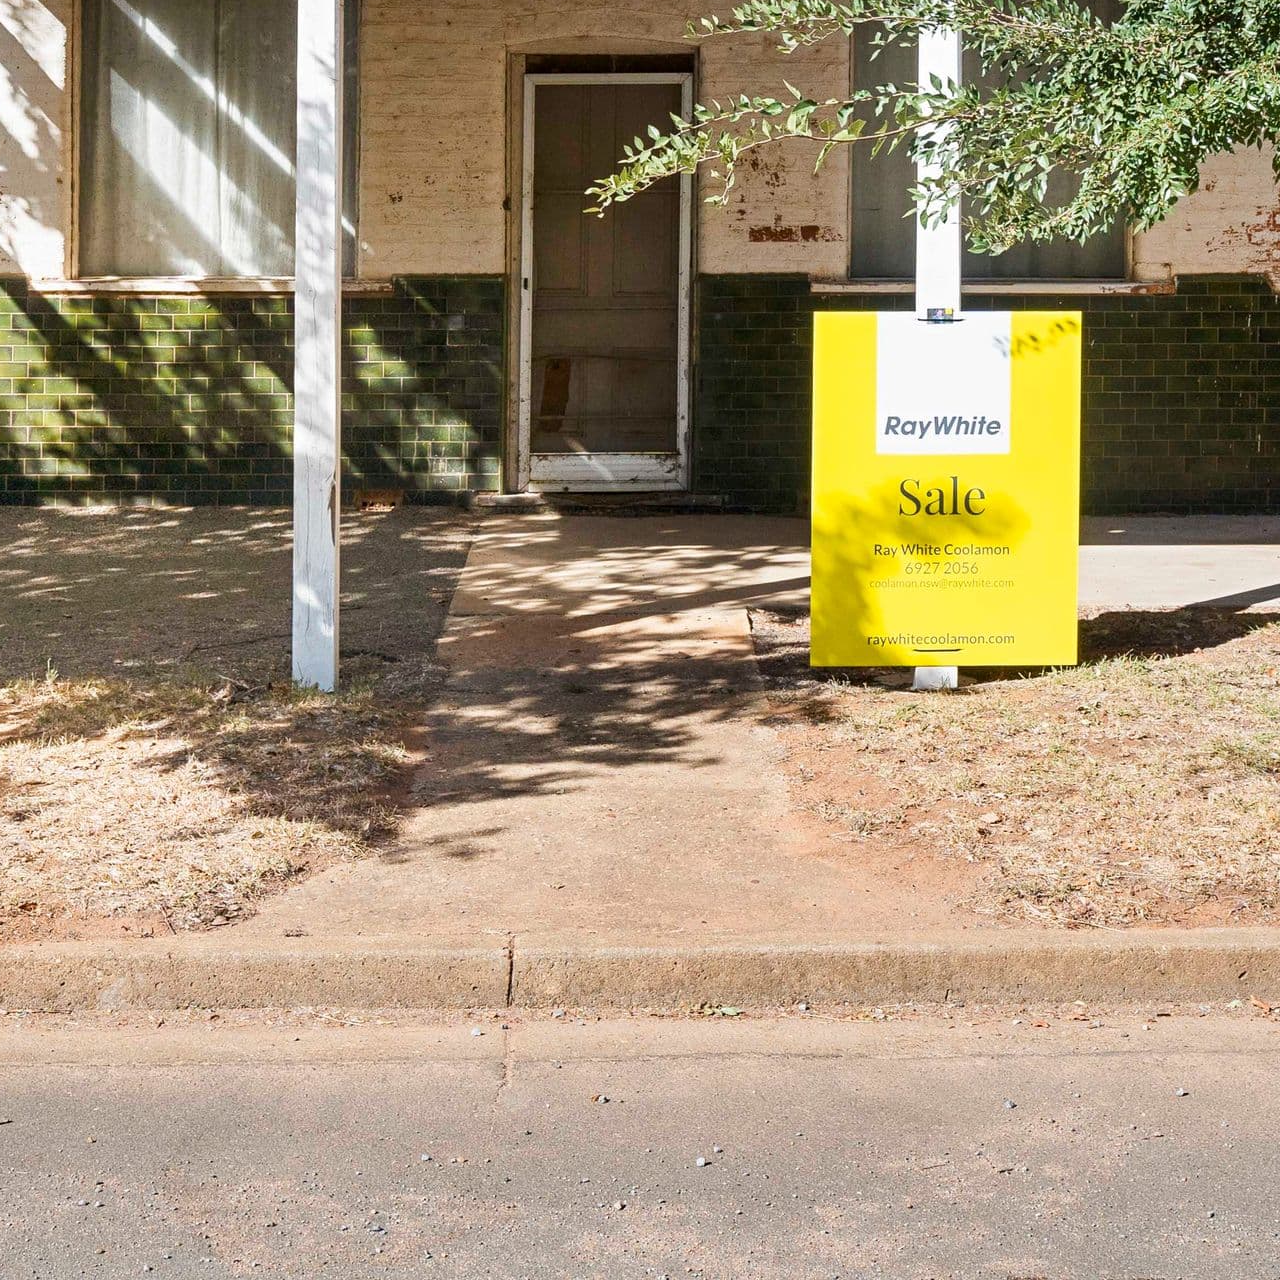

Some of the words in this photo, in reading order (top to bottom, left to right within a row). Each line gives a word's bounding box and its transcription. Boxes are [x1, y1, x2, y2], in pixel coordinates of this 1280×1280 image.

[898, 476, 986, 517] Sale
[873, 544, 897, 557] Ray
[901, 543, 941, 556] White
[944, 543, 1010, 556] Coolamon
[904, 562, 940, 575] 6927
[943, 562, 979, 575] 2056
[867, 633, 1015, 647] raywhitecoolamon.com
